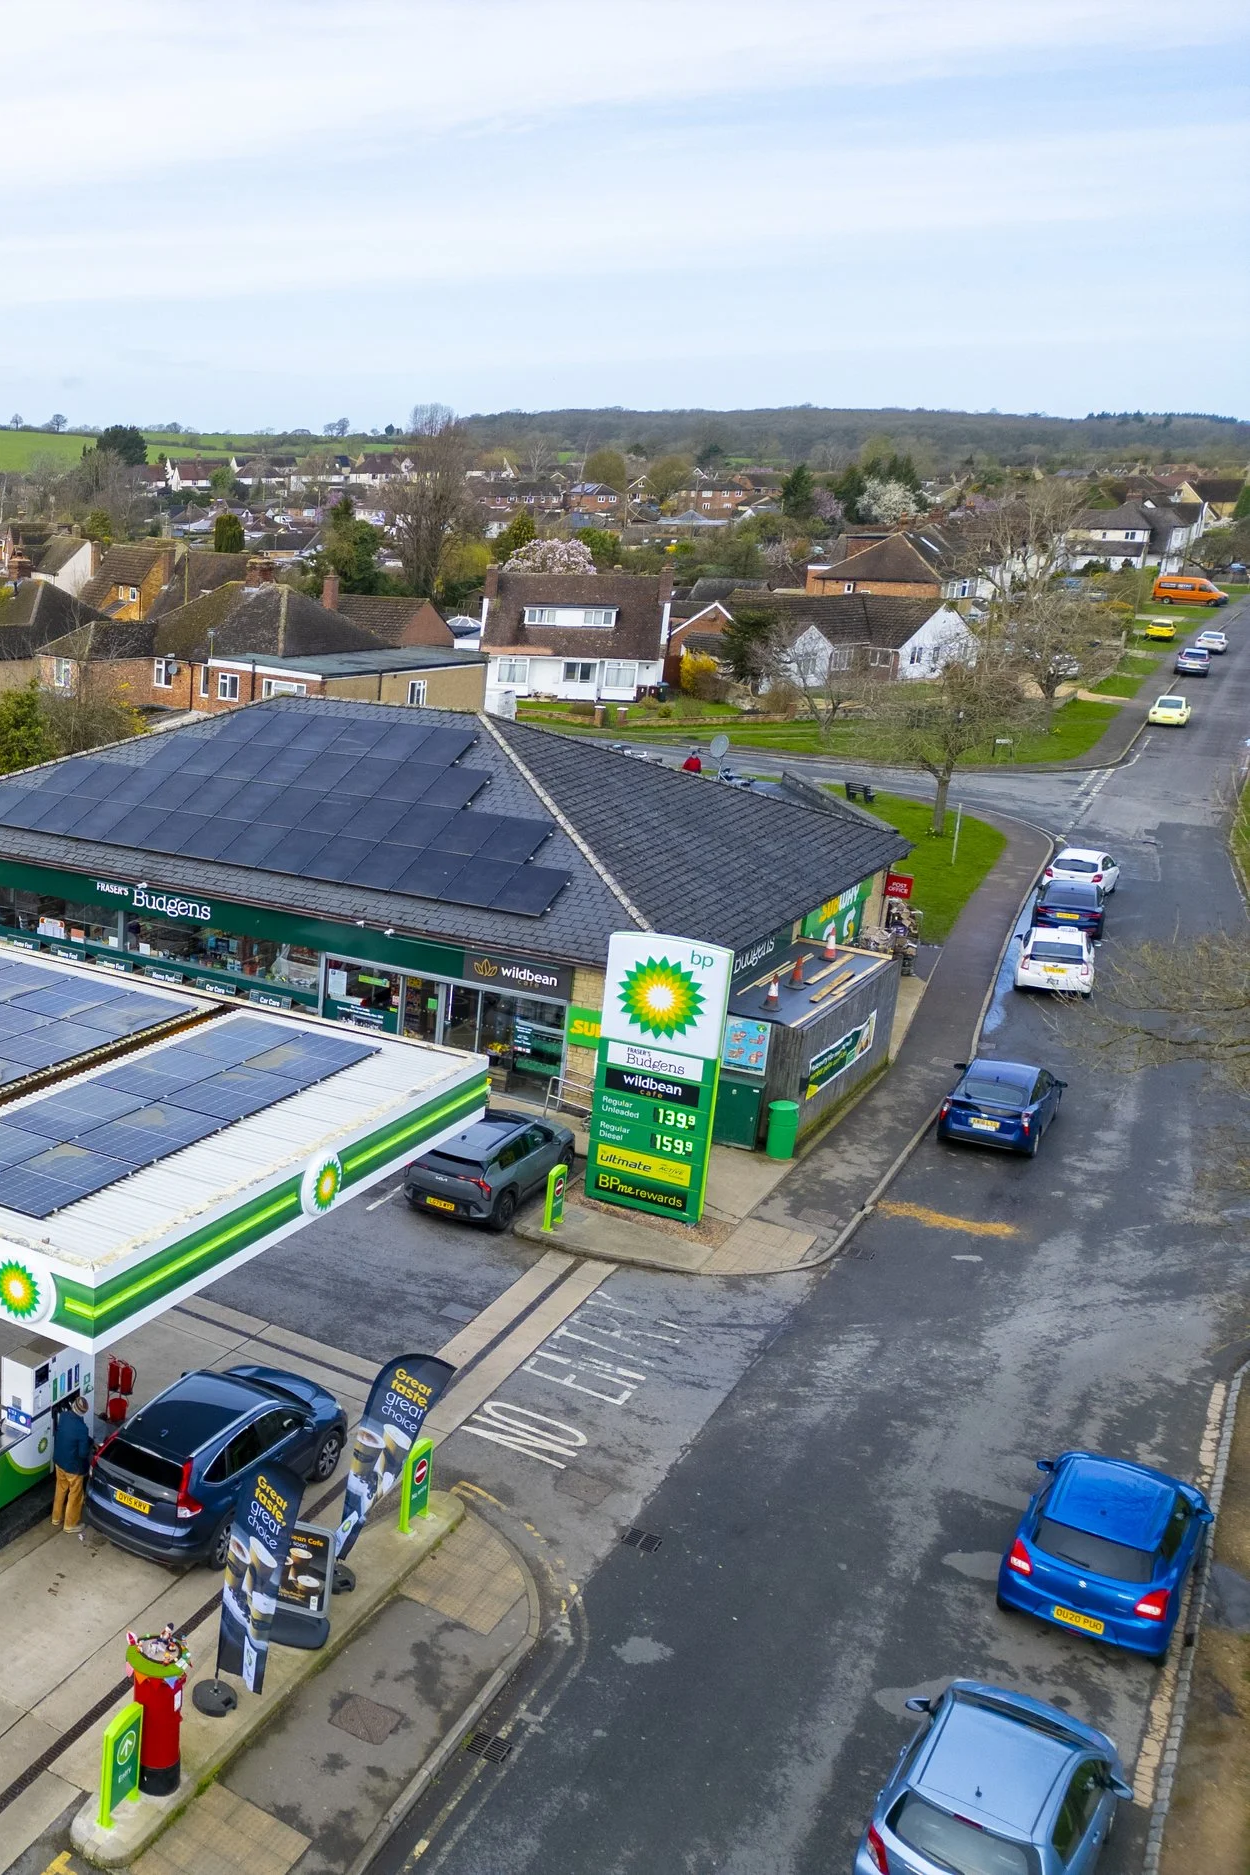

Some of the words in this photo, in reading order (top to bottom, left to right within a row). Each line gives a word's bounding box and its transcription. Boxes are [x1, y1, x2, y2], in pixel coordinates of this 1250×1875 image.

[96, 881, 129, 896] FRASER'S
[132, 889, 211, 920] Budgens
[888, 886, 908, 894] OFFICE
[819, 883, 862, 921] SUBWAY
[690, 949, 714, 970] bp
[501, 966, 558, 987] wildbean
[205, 983, 214, 991] Car
[214, 986, 225, 994] Care
[259, 996, 268, 1004] Car
[268, 998, 280, 1007] Care
[627, 1046, 651, 1056] FRASER'S
[626, 1053, 685, 1075] Budgens
[623, 1074, 682, 1096] wildbean
[639, 1089, 663, 1099] cafe
[601, 1104, 640, 1119] Unleaded
[602, 1095, 633, 1109] Regular
[599, 1120, 631, 1134] Regular
[599, 1129, 623, 1141] Diesel
[600, 1153, 652, 1173] ultimate
[395, 1368, 432, 1397] Great
[385, 1391, 424, 1420] great
[391, 1379, 428, 1412] taste,
[381, 1405, 418, 1433] choice
[460, 1401, 588, 1470] NO
[257, 1475, 288, 1511] Great
[254, 1487, 287, 1527] taste,
[250, 1500, 282, 1536] great
[247, 1515, 278, 1550] choice
[291, 1535, 307, 1543] ean
[1056, 1608, 1081, 1623] OU20
[118, 1765, 132, 1784] Entry
